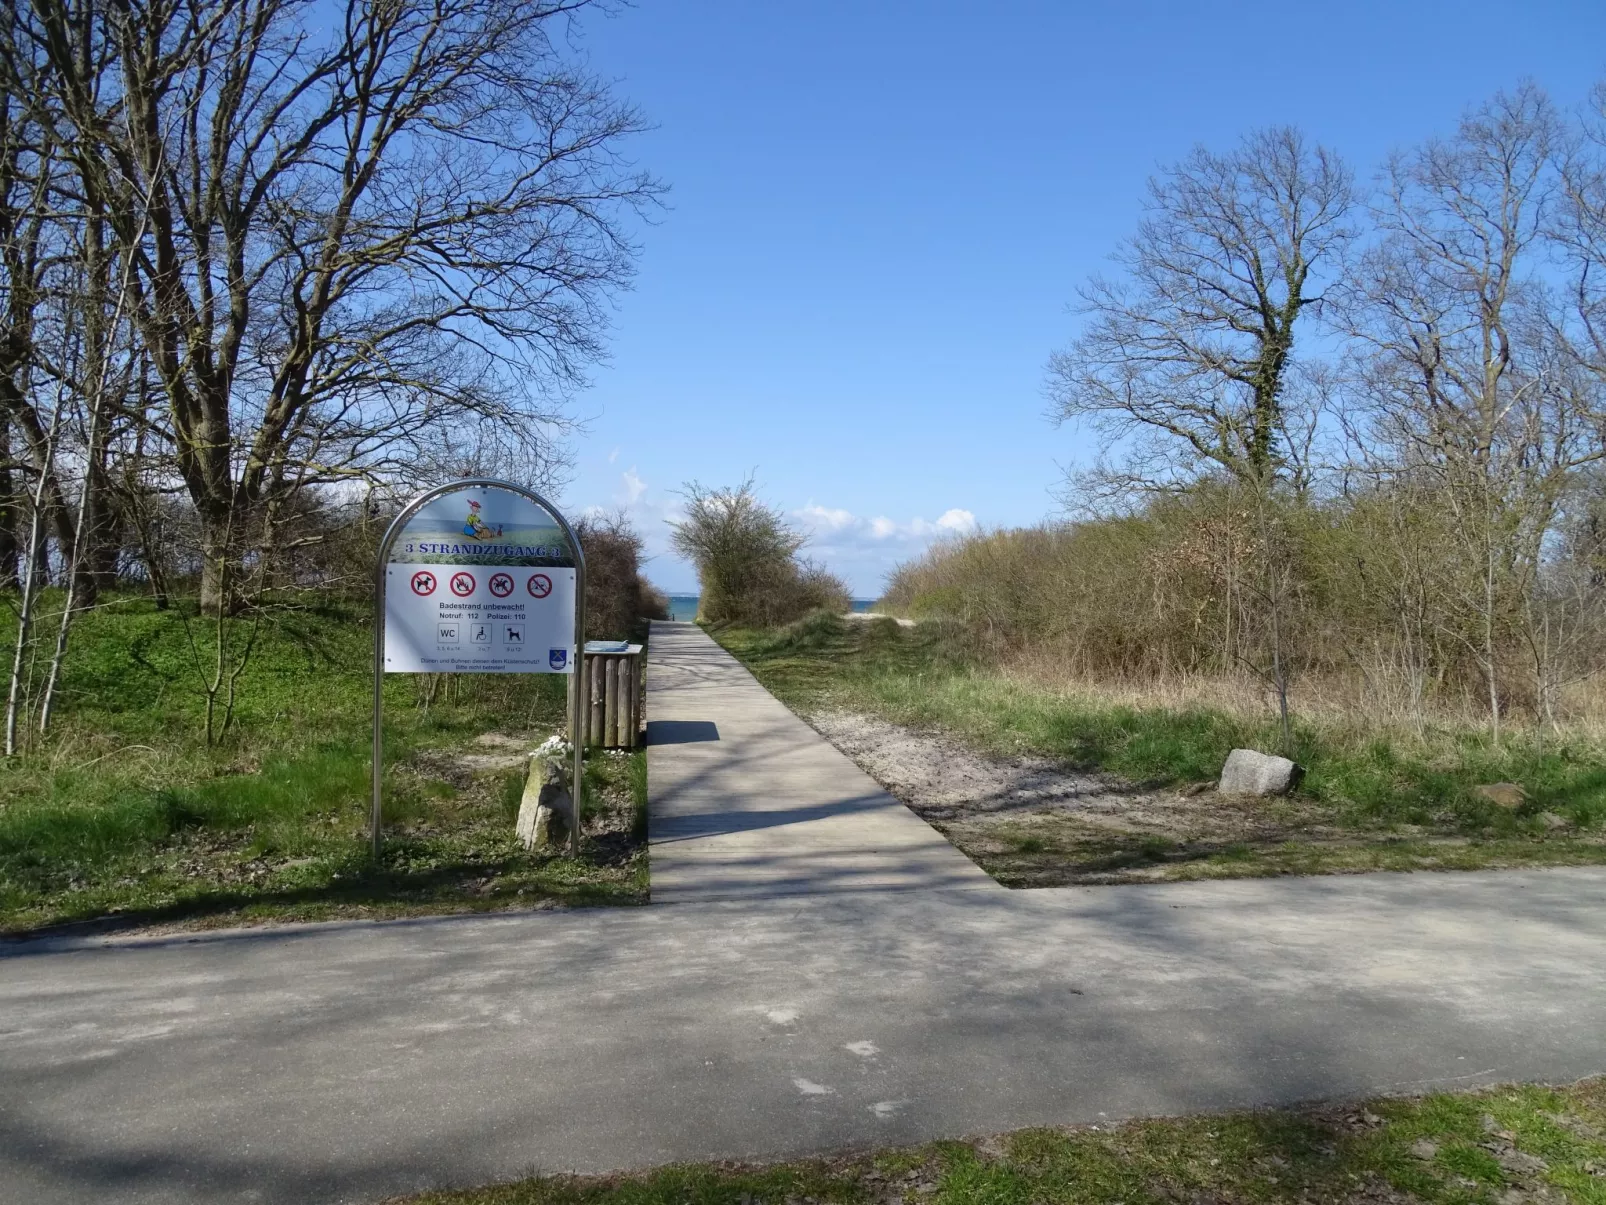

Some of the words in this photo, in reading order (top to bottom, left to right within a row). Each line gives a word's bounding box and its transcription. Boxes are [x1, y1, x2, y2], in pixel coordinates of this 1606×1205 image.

[406, 543, 414, 553] 3
[419, 543, 546, 557] STRANDZUGANG
[551, 547, 560, 557] 3
[439, 602, 481, 610] Badestrand
[483, 603, 525, 611] unbewacht!
[440, 629, 455, 638] WC
